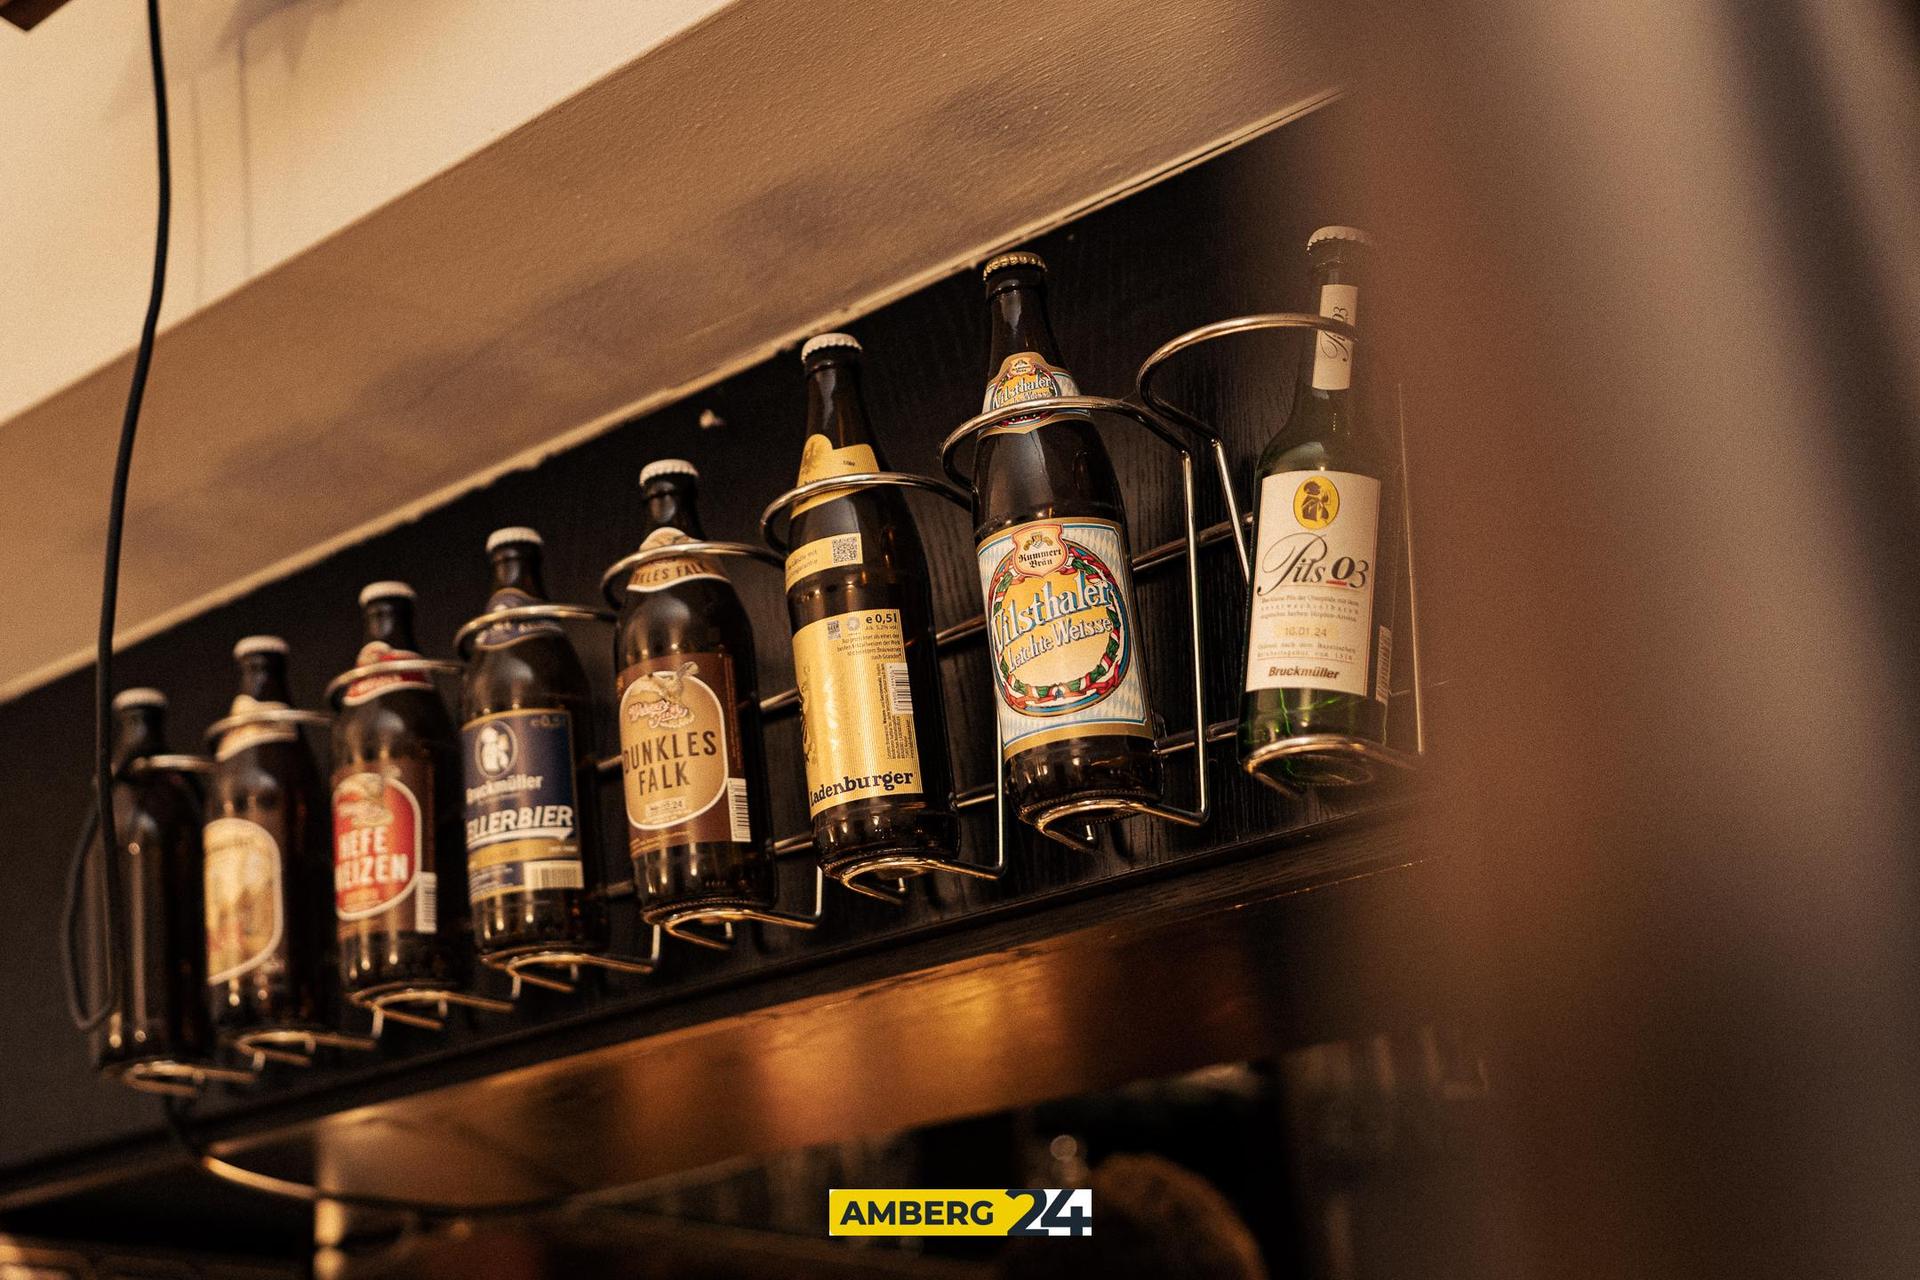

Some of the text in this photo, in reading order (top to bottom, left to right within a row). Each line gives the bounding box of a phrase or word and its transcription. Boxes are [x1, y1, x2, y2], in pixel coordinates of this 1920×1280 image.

[1257, 532, 1369, 596] Pils 03
[1052, 617, 1113, 647] Weisse
[1268, 667, 1340, 679] Bruckmüller
[623, 731, 717, 774] DUNKLES
[639, 761, 691, 796] FALK
